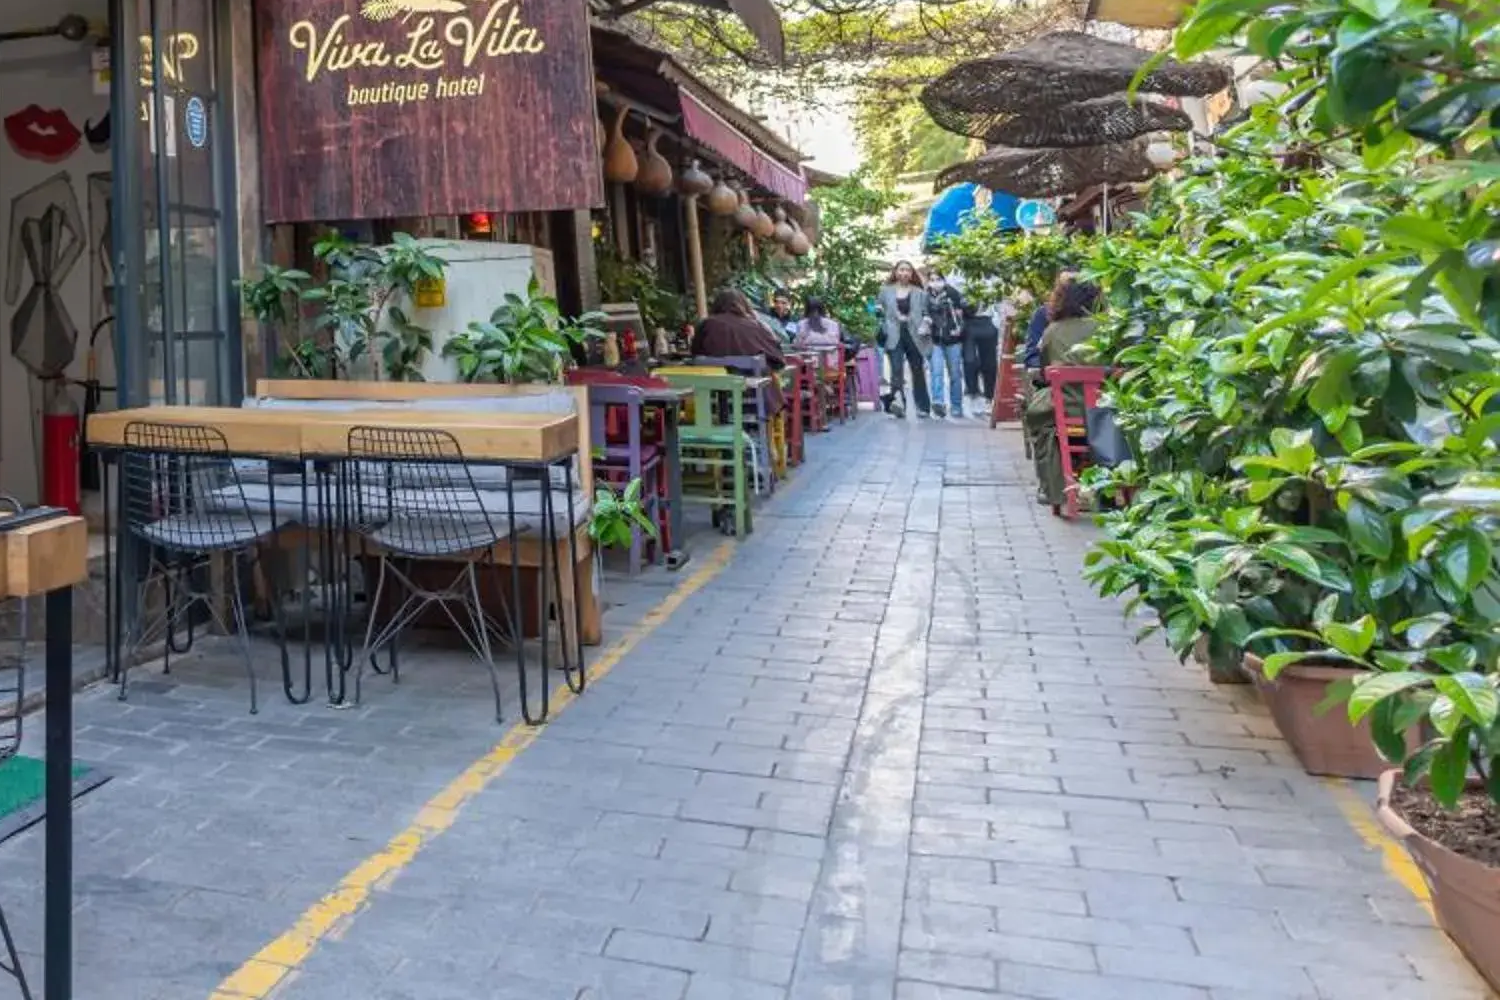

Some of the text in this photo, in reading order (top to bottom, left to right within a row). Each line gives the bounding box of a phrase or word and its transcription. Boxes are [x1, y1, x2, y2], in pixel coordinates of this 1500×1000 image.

[289, 14, 390, 83] Viva
[395, 17, 445, 70] La
[347, 73, 486, 106] boutique hotel
